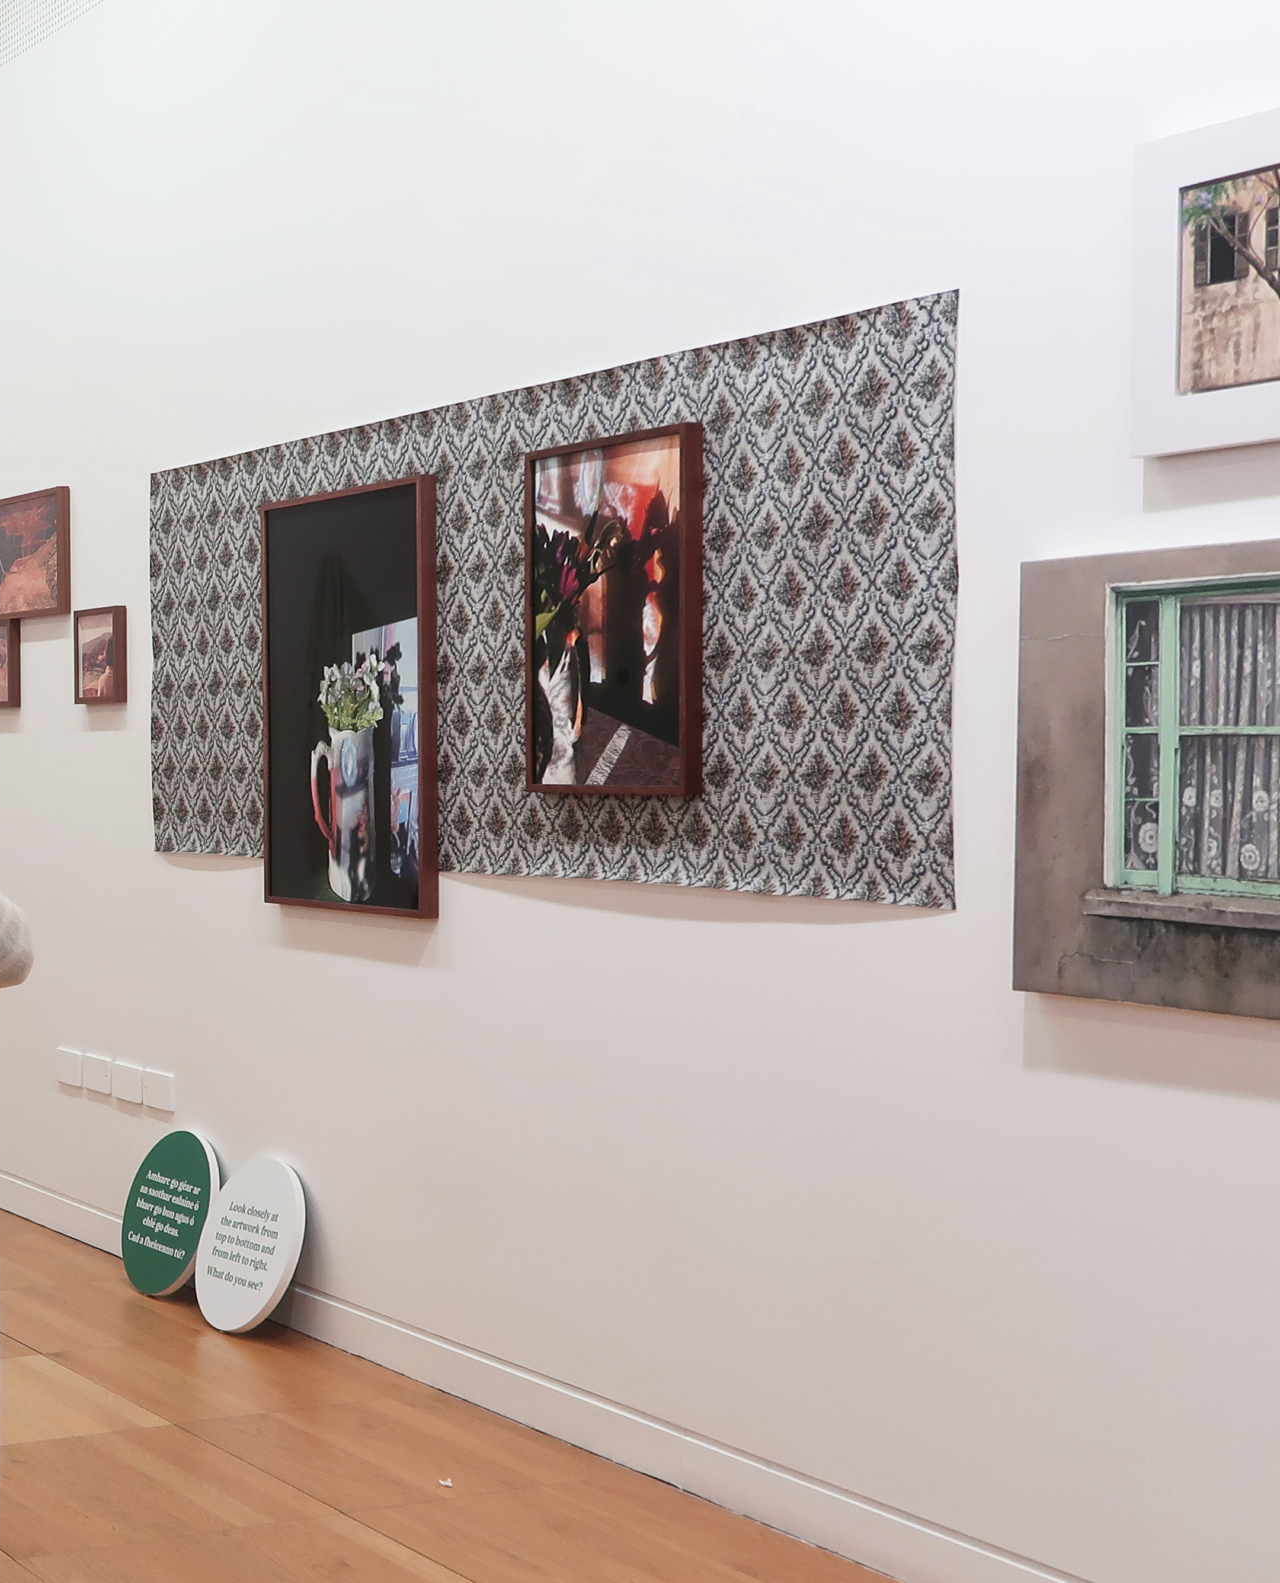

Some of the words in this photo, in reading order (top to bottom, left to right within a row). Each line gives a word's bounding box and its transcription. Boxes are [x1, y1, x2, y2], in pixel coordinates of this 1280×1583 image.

[146, 1170, 170, 1185] Amharc
[170, 1179, 178, 1189] go
[178, 1180, 193, 1192] géar
[193, 1187, 201, 1195] ar
[140, 1185, 148, 1193] an
[194, 1201, 200, 1210] ó
[153, 1205, 162, 1215] go
[162, 1206, 175, 1219] bun
[175, 1212, 189, 1224] agus
[189, 1215, 195, 1225] ó
[229, 1201, 246, 1214] Look
[247, 1206, 270, 1222] closely
[271, 1213, 279, 1222] at
[142, 1216, 157, 1228] chlé
[155, 1221, 163, 1232] go
[164, 1224, 179, 1237] deas.
[221, 1216, 232, 1227] the
[232, 1221, 260, 1234] artwork
[261, 1226, 279, 1239] from
[128, 1231, 139, 1243] Cad
[139, 1237, 144, 1245] a
[174, 1248, 185, 1259] tú?
[215, 1232, 227, 1244] top
[227, 1235, 235, 1244] to
[235, 1236, 261, 1251] bottom
[261, 1245, 275, 1255] and
[212, 1246, 228, 1259] from
[229, 1251, 241, 1263] left
[242, 1255, 249, 1265] to
[250, 1257, 268, 1271] right.
[207, 1265, 224, 1279] What
[225, 1272, 233, 1282] do
[233, 1276, 247, 1286] you
[248, 1281, 263, 1291] see?
